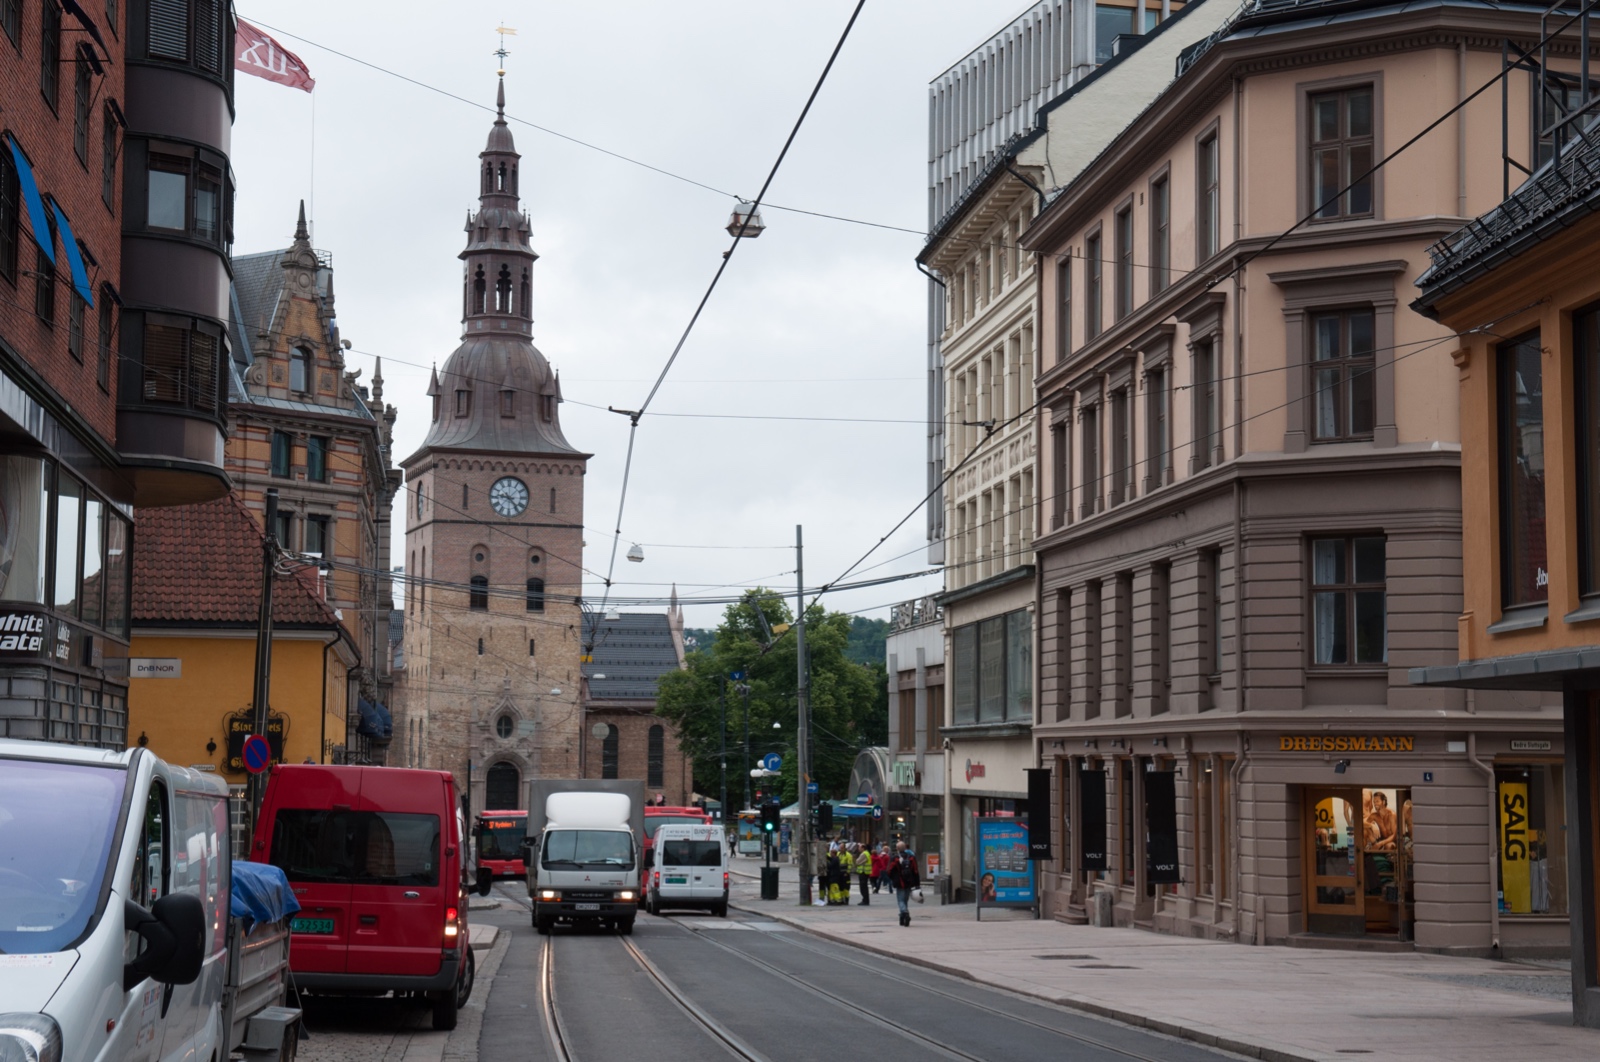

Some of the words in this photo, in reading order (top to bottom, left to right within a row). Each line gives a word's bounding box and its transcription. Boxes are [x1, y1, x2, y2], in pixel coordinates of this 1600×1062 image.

[1279, 736, 1414, 752] DRESSMANN
[873, 808, 881, 817] N
[1504, 792, 1526, 862] SALG
[300, 919, 331, 930] 52534
